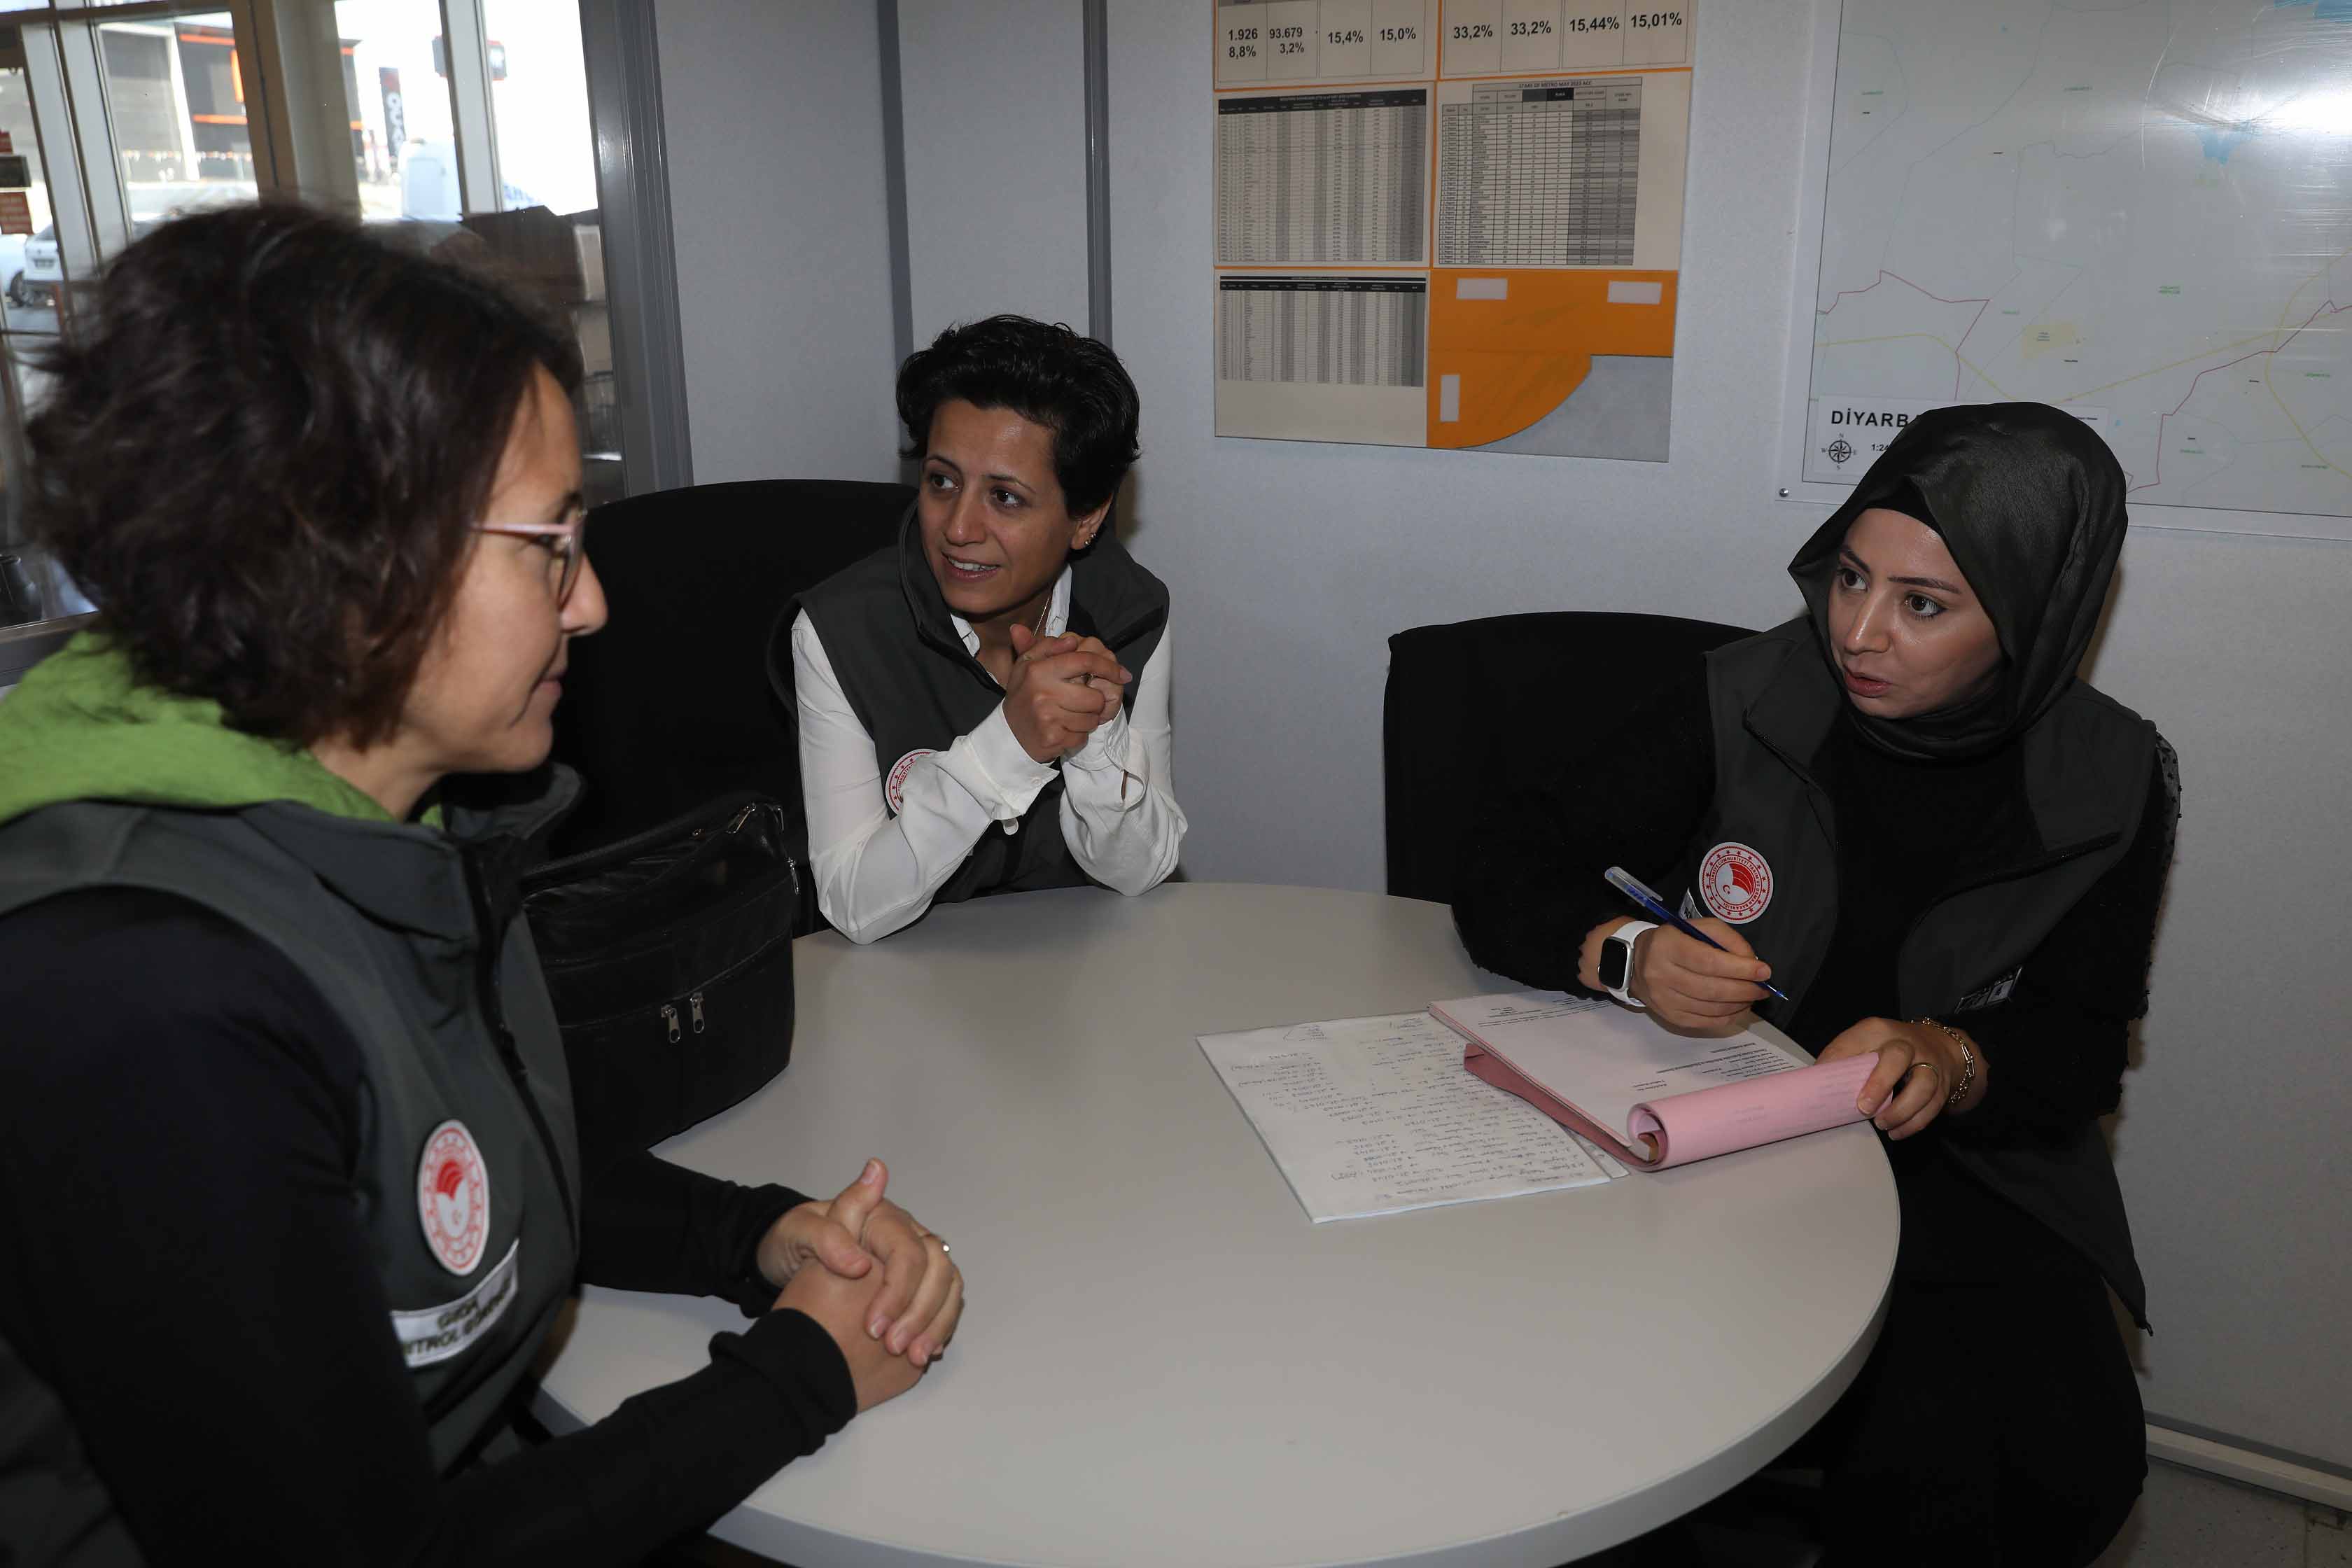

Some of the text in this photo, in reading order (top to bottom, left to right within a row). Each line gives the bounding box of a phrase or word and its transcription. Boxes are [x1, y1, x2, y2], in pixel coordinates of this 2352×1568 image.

[1569, 16, 1620, 33] 15,44%
[1630, 11, 1682, 29] 15,01%
[1228, 27, 1259, 41] 1.926
[1269, 27, 1303, 39] 93.679
[1380, 27, 1417, 42] 15,0%
[1453, 24, 1493, 40] 33,2%
[1511, 20, 1552, 37] 33,2%
[1328, 30, 1364, 46] 15,4%
[1228, 45, 1256, 60] 8,8%
[1280, 42, 1305, 55] 3,2%
[1831, 408, 1909, 428] DİYARB
